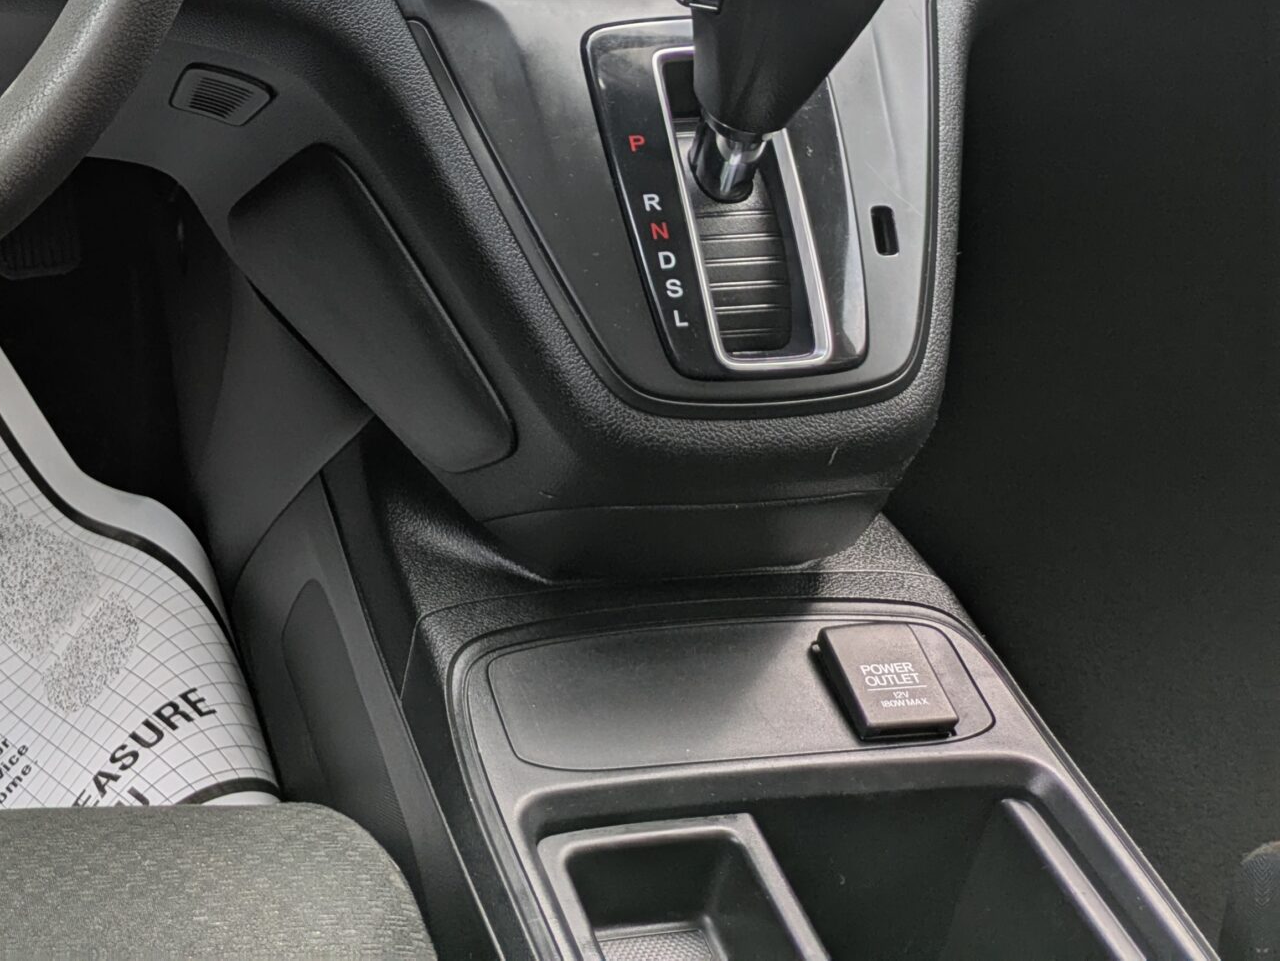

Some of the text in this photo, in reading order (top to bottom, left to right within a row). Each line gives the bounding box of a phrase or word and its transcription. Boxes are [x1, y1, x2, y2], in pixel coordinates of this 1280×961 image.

[628, 134, 645, 152] P
[643, 193, 662, 212] R
[650, 222, 669, 240] N
[658, 251, 676, 270] D
[666, 278, 684, 298] S
[674, 310, 689, 327] L
[860, 662, 914, 676] POWER
[865, 672, 920, 687] OUTLET
[893, 690, 908, 699] 12V
[71, 688, 218, 808] EASURE
